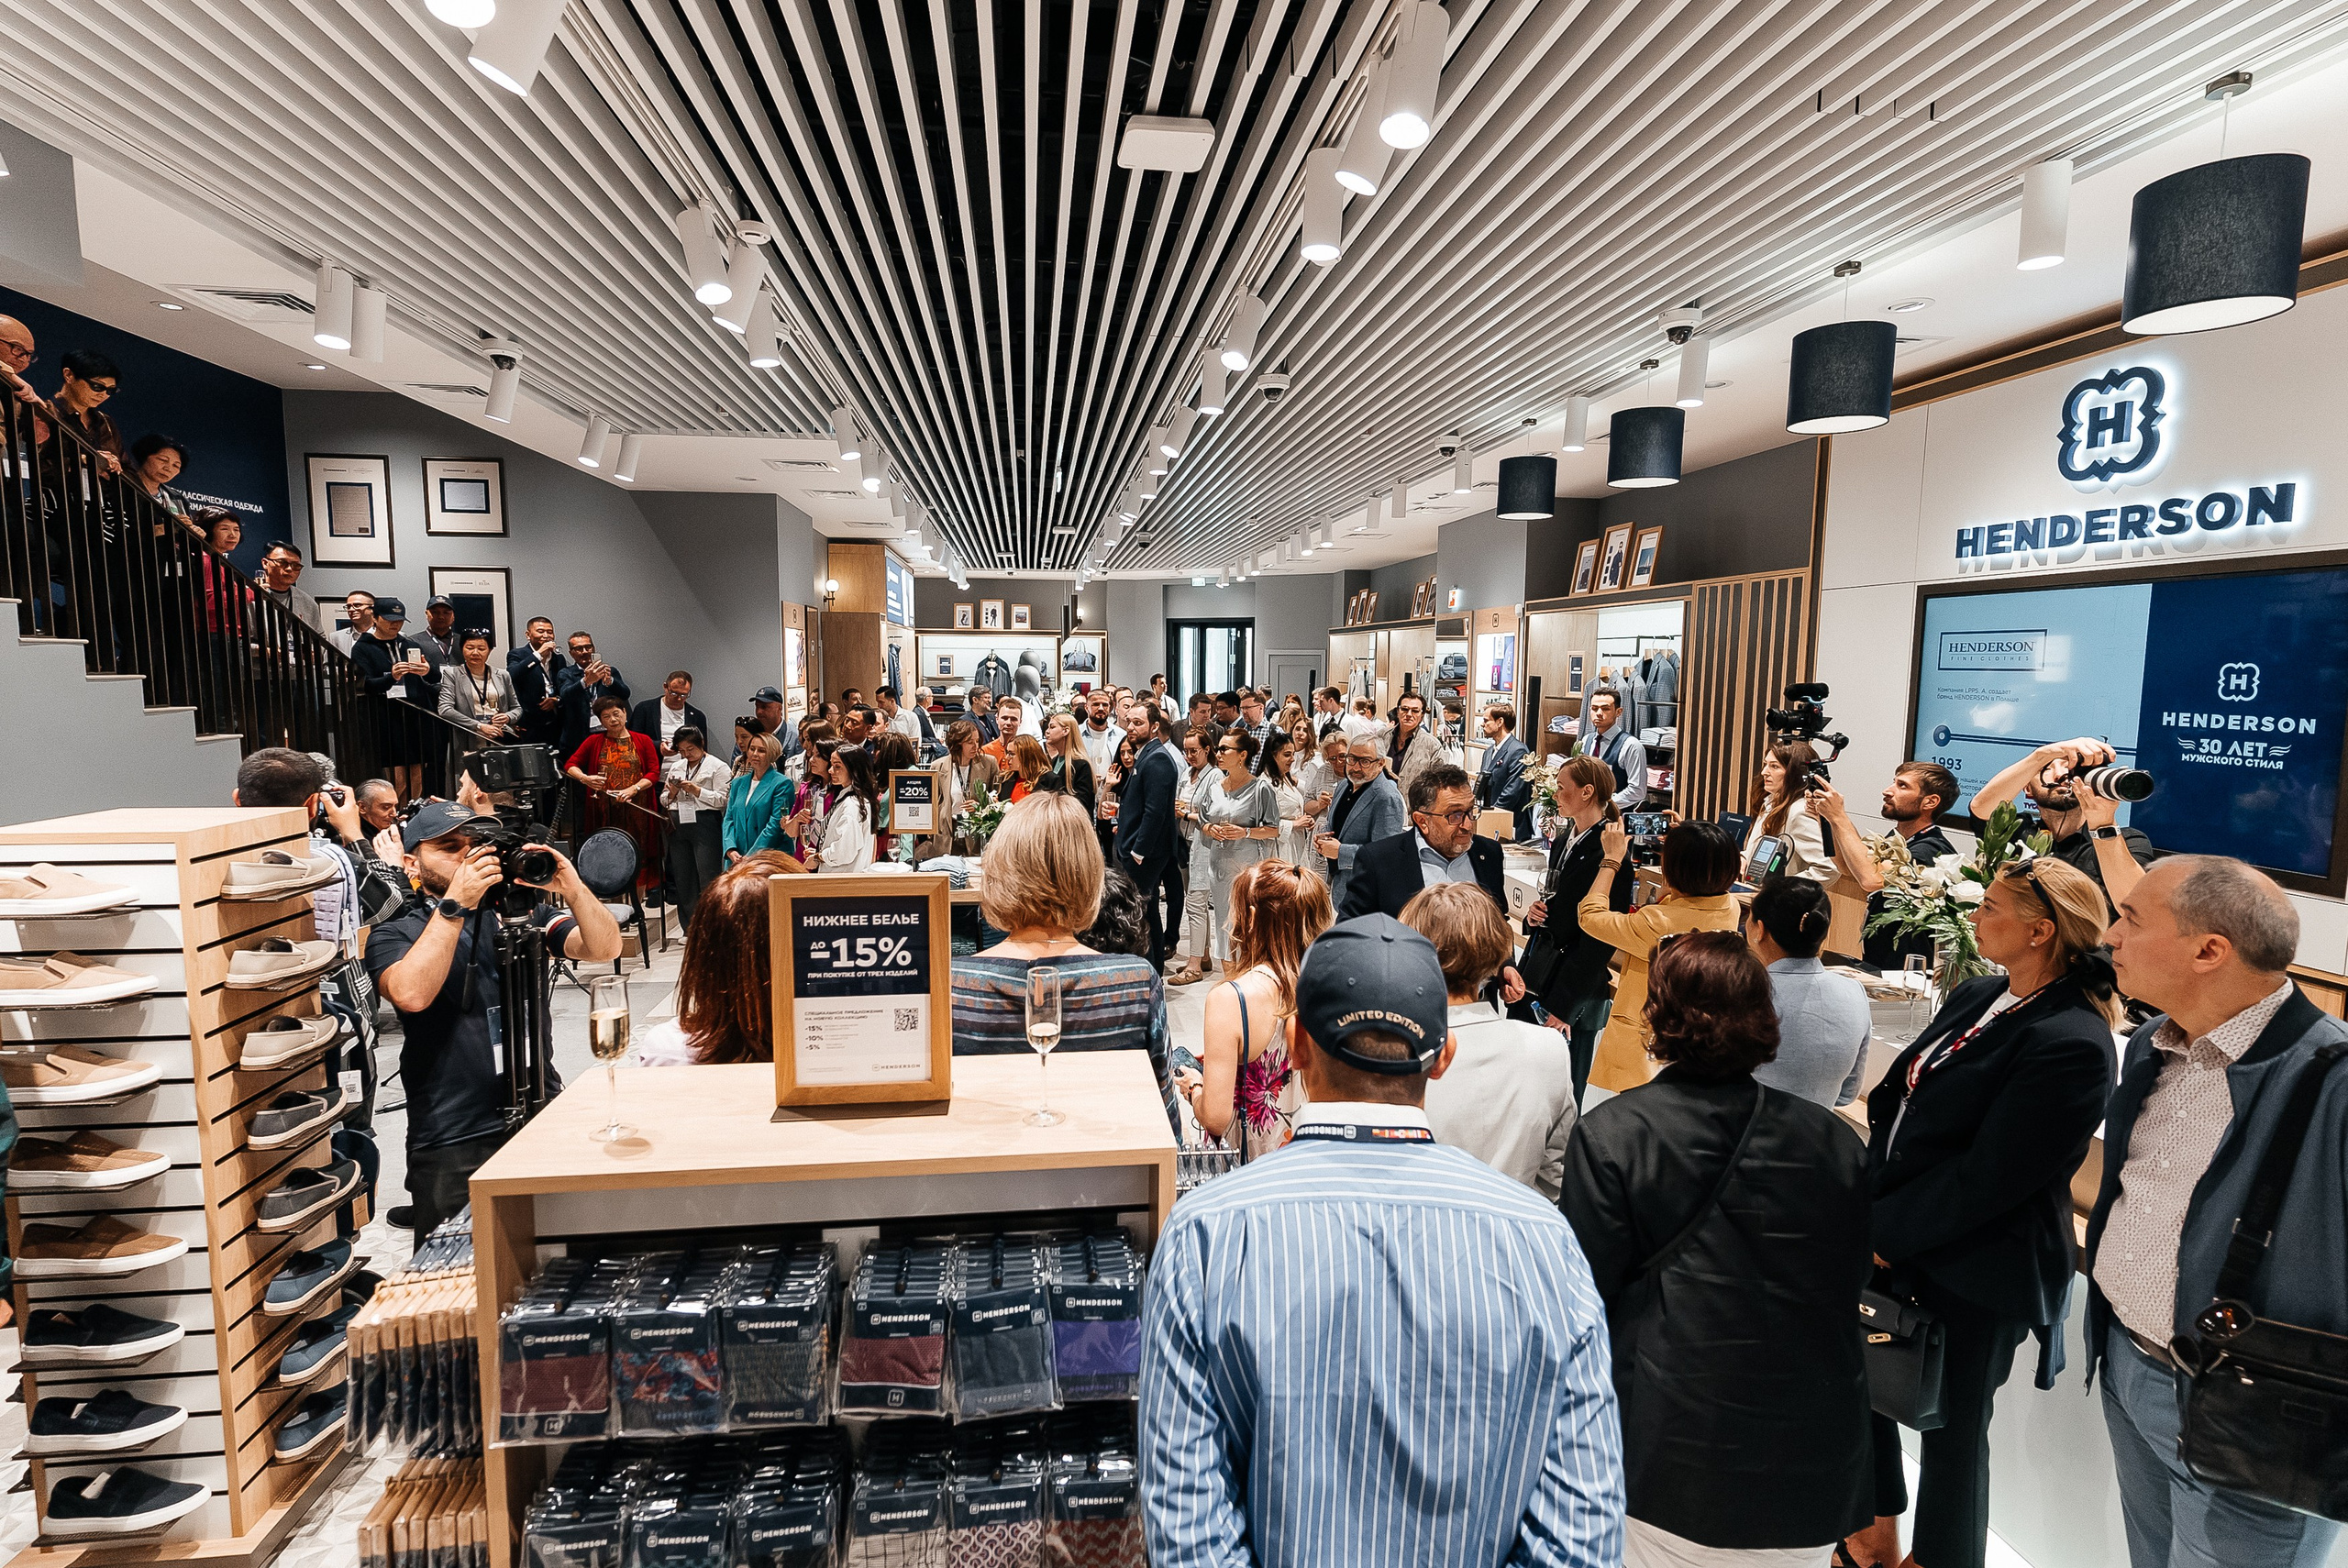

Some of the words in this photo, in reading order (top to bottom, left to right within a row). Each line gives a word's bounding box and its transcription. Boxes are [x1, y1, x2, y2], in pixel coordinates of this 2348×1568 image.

[2086, 400, 2134, 449] H
[178, 490, 234, 507] ЛАССИЧЕСКАЯ
[233, 501, 264, 513] ОДЕЖДА
[1955, 482, 2296, 559] HENDERSON
[1948, 641, 2034, 653] HENDERSON
[2229, 674, 2248, 690] H
[2162, 712, 2317, 734] HENDERSON
[2198, 738, 2222, 755] 30
[2227, 740, 2268, 757] ЛЕТ
[2181, 753, 2243, 767] МУЖСКОГО
[2244, 758, 2284, 770] СТИЛЯ
[900, 787, 929, 796] -20%
[803, 914, 869, 927] НИЖНЕЕ
[872, 913, 920, 925] БЕЛЬЕ
[810, 941, 826, 950] ДО
[810, 936, 913, 967] -15%
[885, 968, 918, 977] ИЗДЕЛИЙ
[1337, 1010, 1384, 1027] LIMITED
[1385, 1010, 1425, 1040] EDITION
[1076, 1298, 1123, 1307] HENDERSON
[983, 1303, 1031, 1319] HENDERSON
[881, 1313, 931, 1323] HENDERSON
[748, 1320, 799, 1330] HENDERSON
[535, 1332, 591, 1343] HENDERSON
[642, 1327, 693, 1337] HENDERSON
[980, 1499, 1026, 1511] HENDERSON
[1079, 1496, 1124, 1506] HENDERSON
[880, 1508, 929, 1520] HENDERSON
[762, 1524, 812, 1538] HENDERSON
[554, 1539, 608, 1552] HENDERSON
[658, 1535, 710, 1545] HENDERSON
